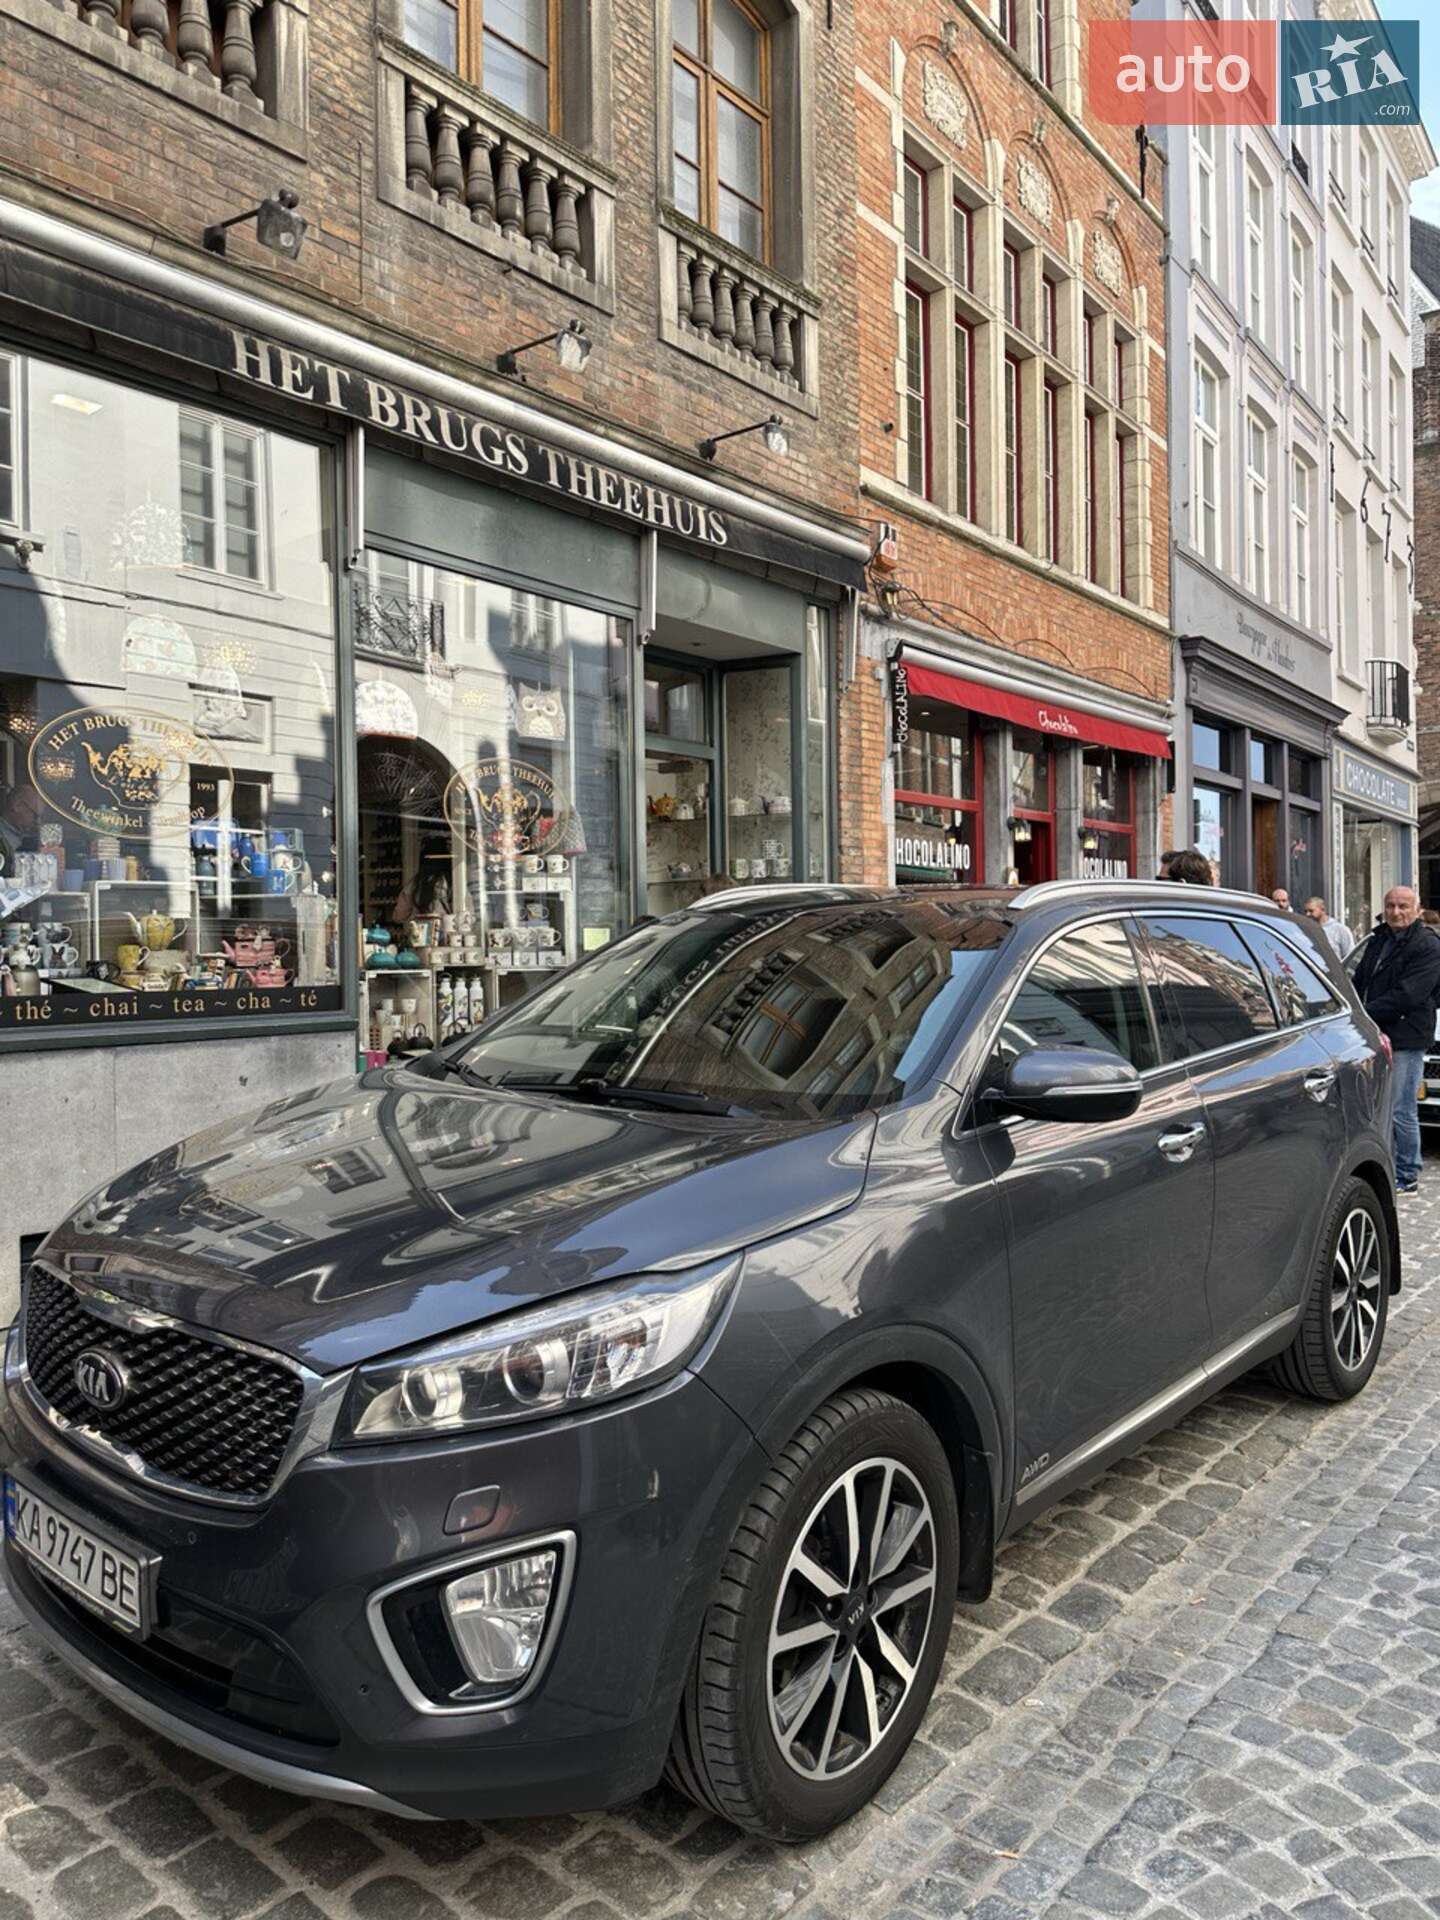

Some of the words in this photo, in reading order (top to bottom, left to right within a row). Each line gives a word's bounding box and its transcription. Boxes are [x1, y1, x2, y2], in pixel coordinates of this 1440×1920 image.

[231, 330, 350, 410] HET
[364, 378, 529, 475] BRUGS
[538, 445, 729, 546] THEEHUIS
[49, 721, 80, 751] HET
[84, 714, 134, 732] BRUG
[71, 795, 144, 828] Theewinkel
[15, 999, 50, 1020] thé
[89, 996, 139, 1017] chai
[173, 997, 205, 1013] tea
[236, 992, 271, 1011] cha
[300, 989, 318, 1007] té
[79, 1360, 110, 1402] KIA
